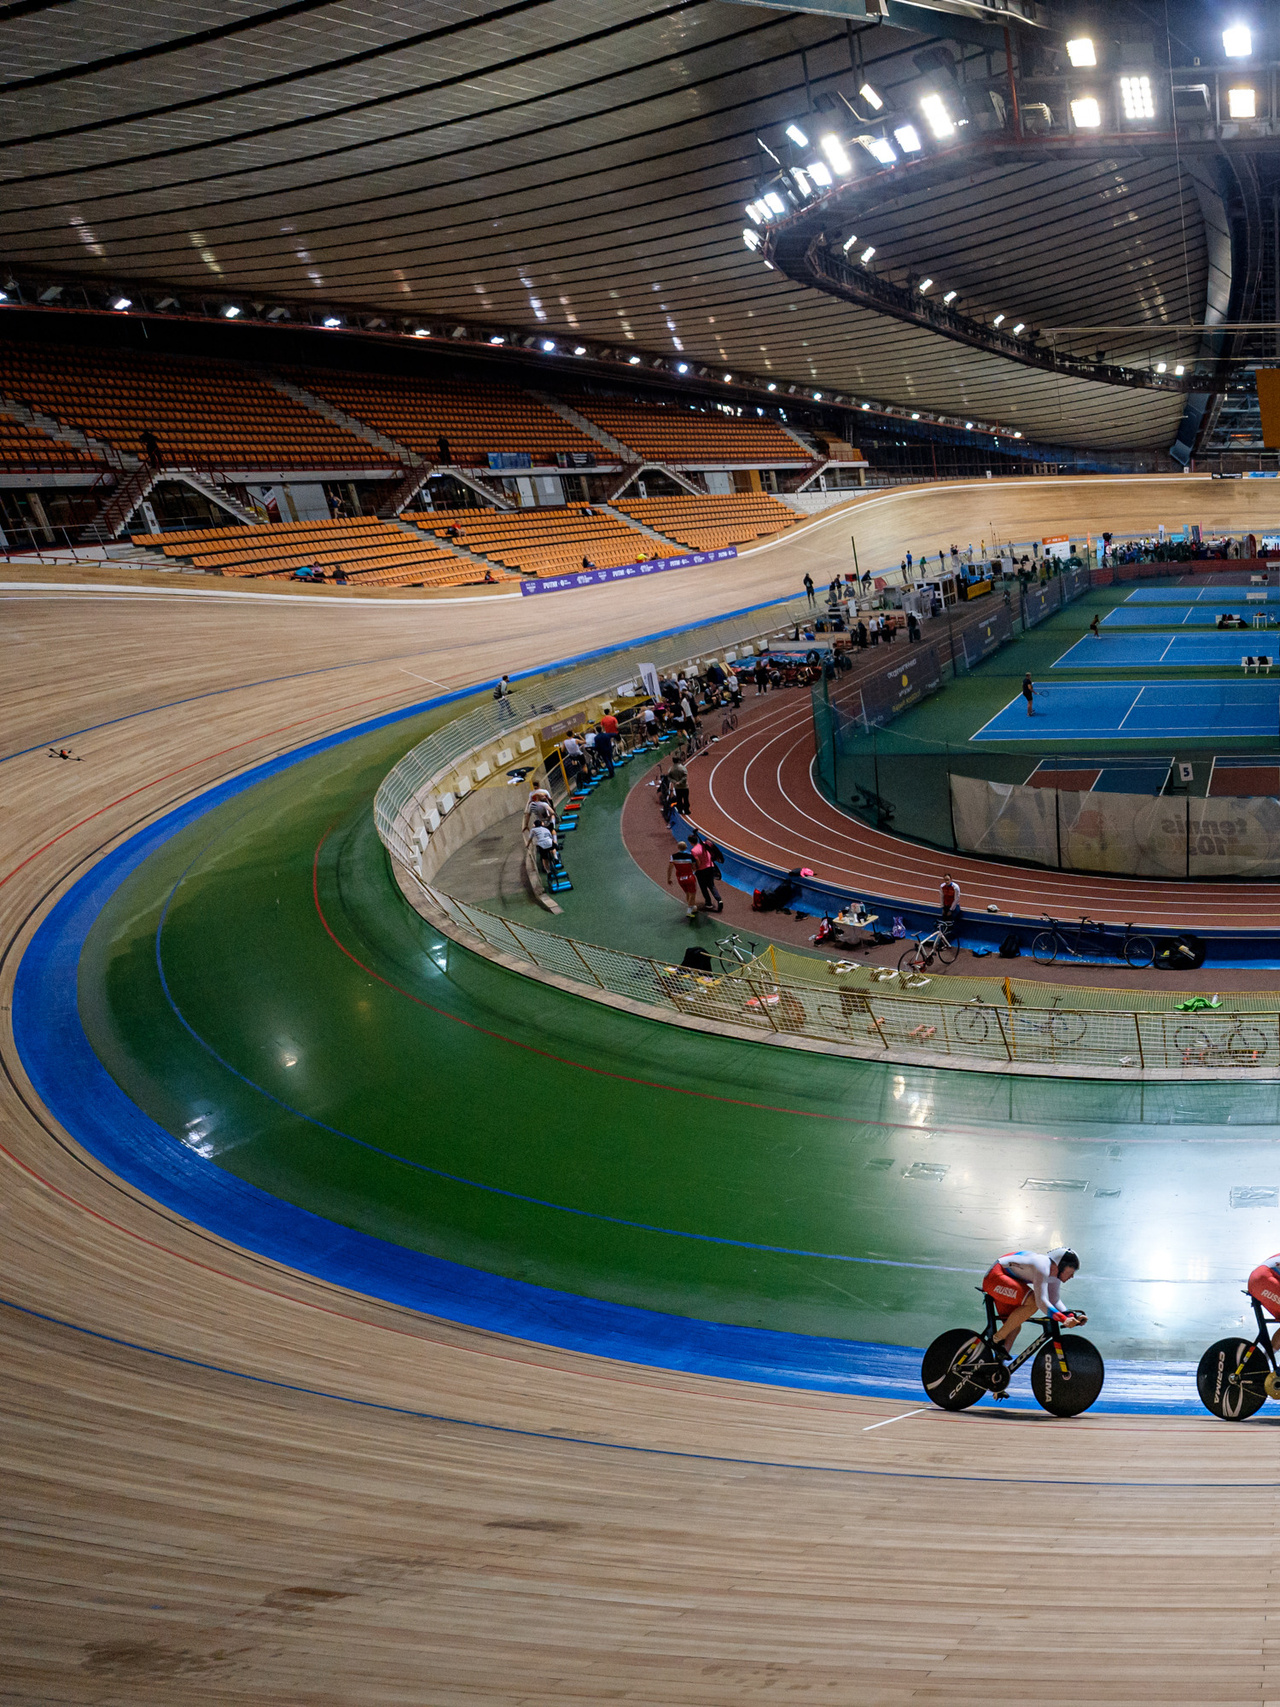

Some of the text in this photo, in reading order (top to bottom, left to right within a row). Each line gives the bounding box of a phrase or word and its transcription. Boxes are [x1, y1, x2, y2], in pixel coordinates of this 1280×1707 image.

[1183, 767, 1190, 777] 5
[993, 1285, 1018, 1299] RUSSIA
[1010, 1333, 1046, 1370] LOOK
[1214, 1351, 1225, 1403] CORIMA
